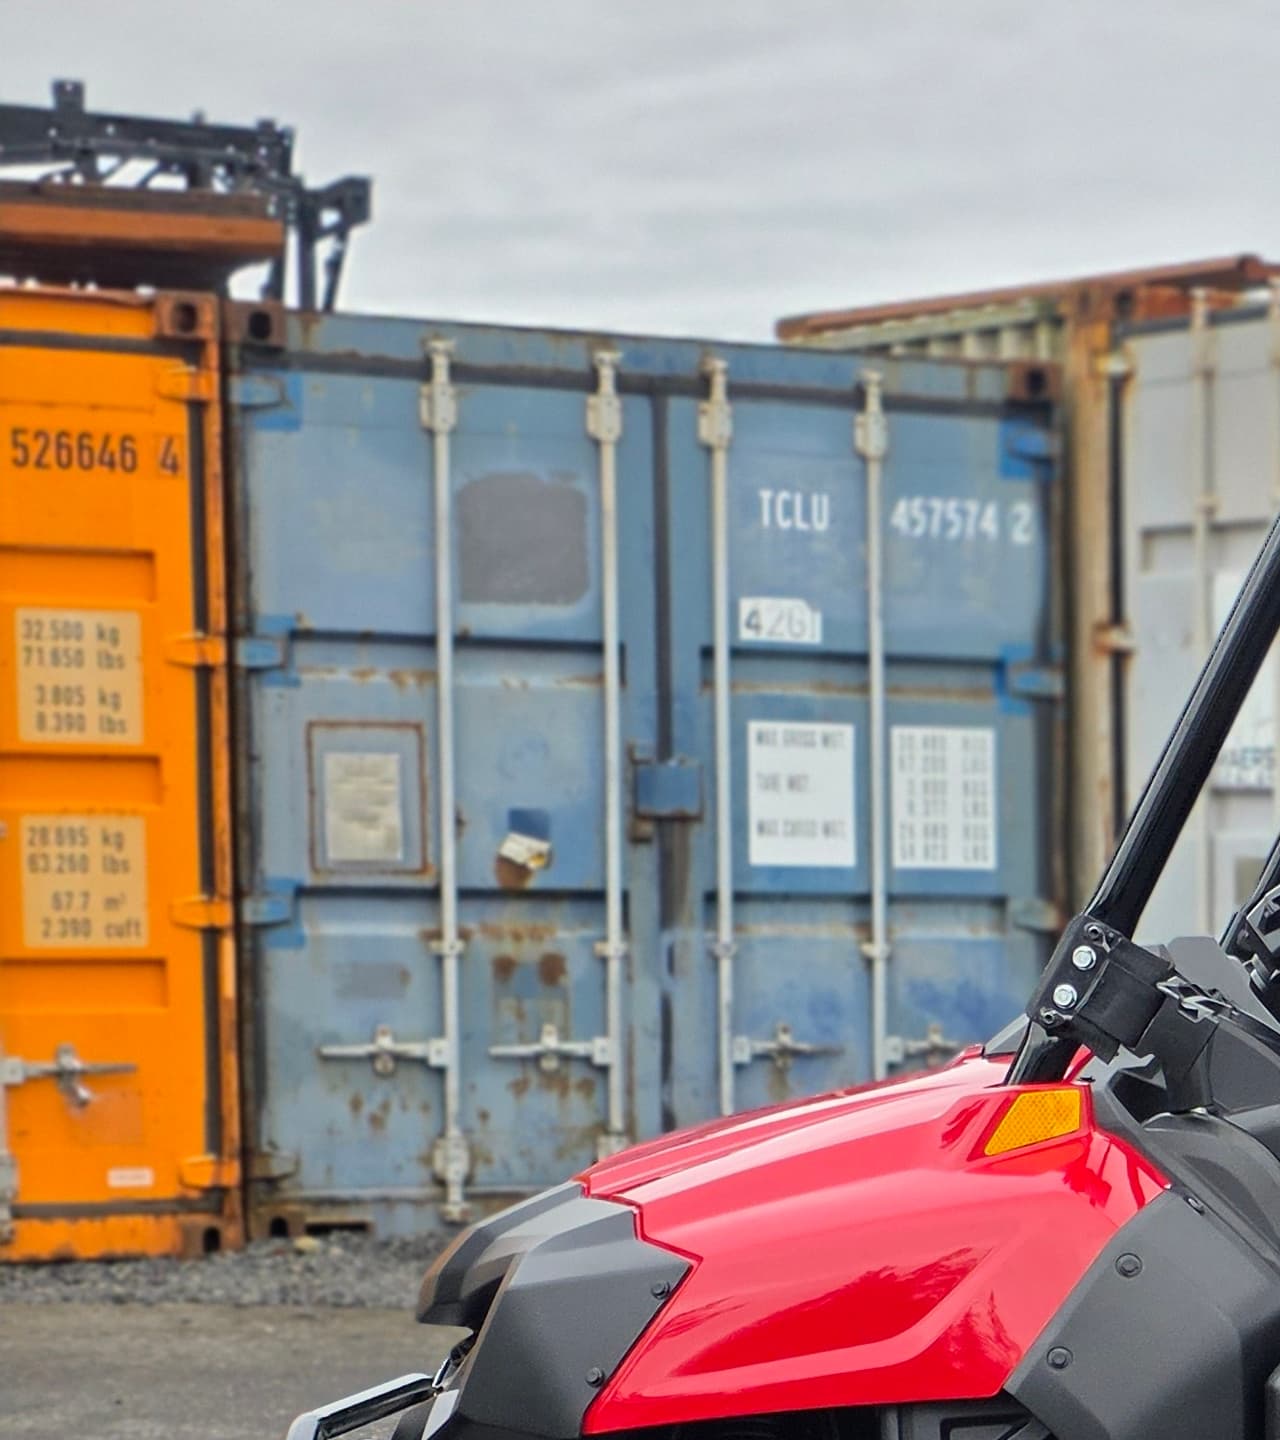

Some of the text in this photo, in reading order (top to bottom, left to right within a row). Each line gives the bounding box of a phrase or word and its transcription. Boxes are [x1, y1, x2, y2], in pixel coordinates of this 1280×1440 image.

[11, 428, 180, 475] 526646 4
[758, 489, 1034, 544] TCLU 457574 2
[96, 622, 120, 648] kg
[98, 687, 121, 712] kg
[101, 828, 125, 853] kg
